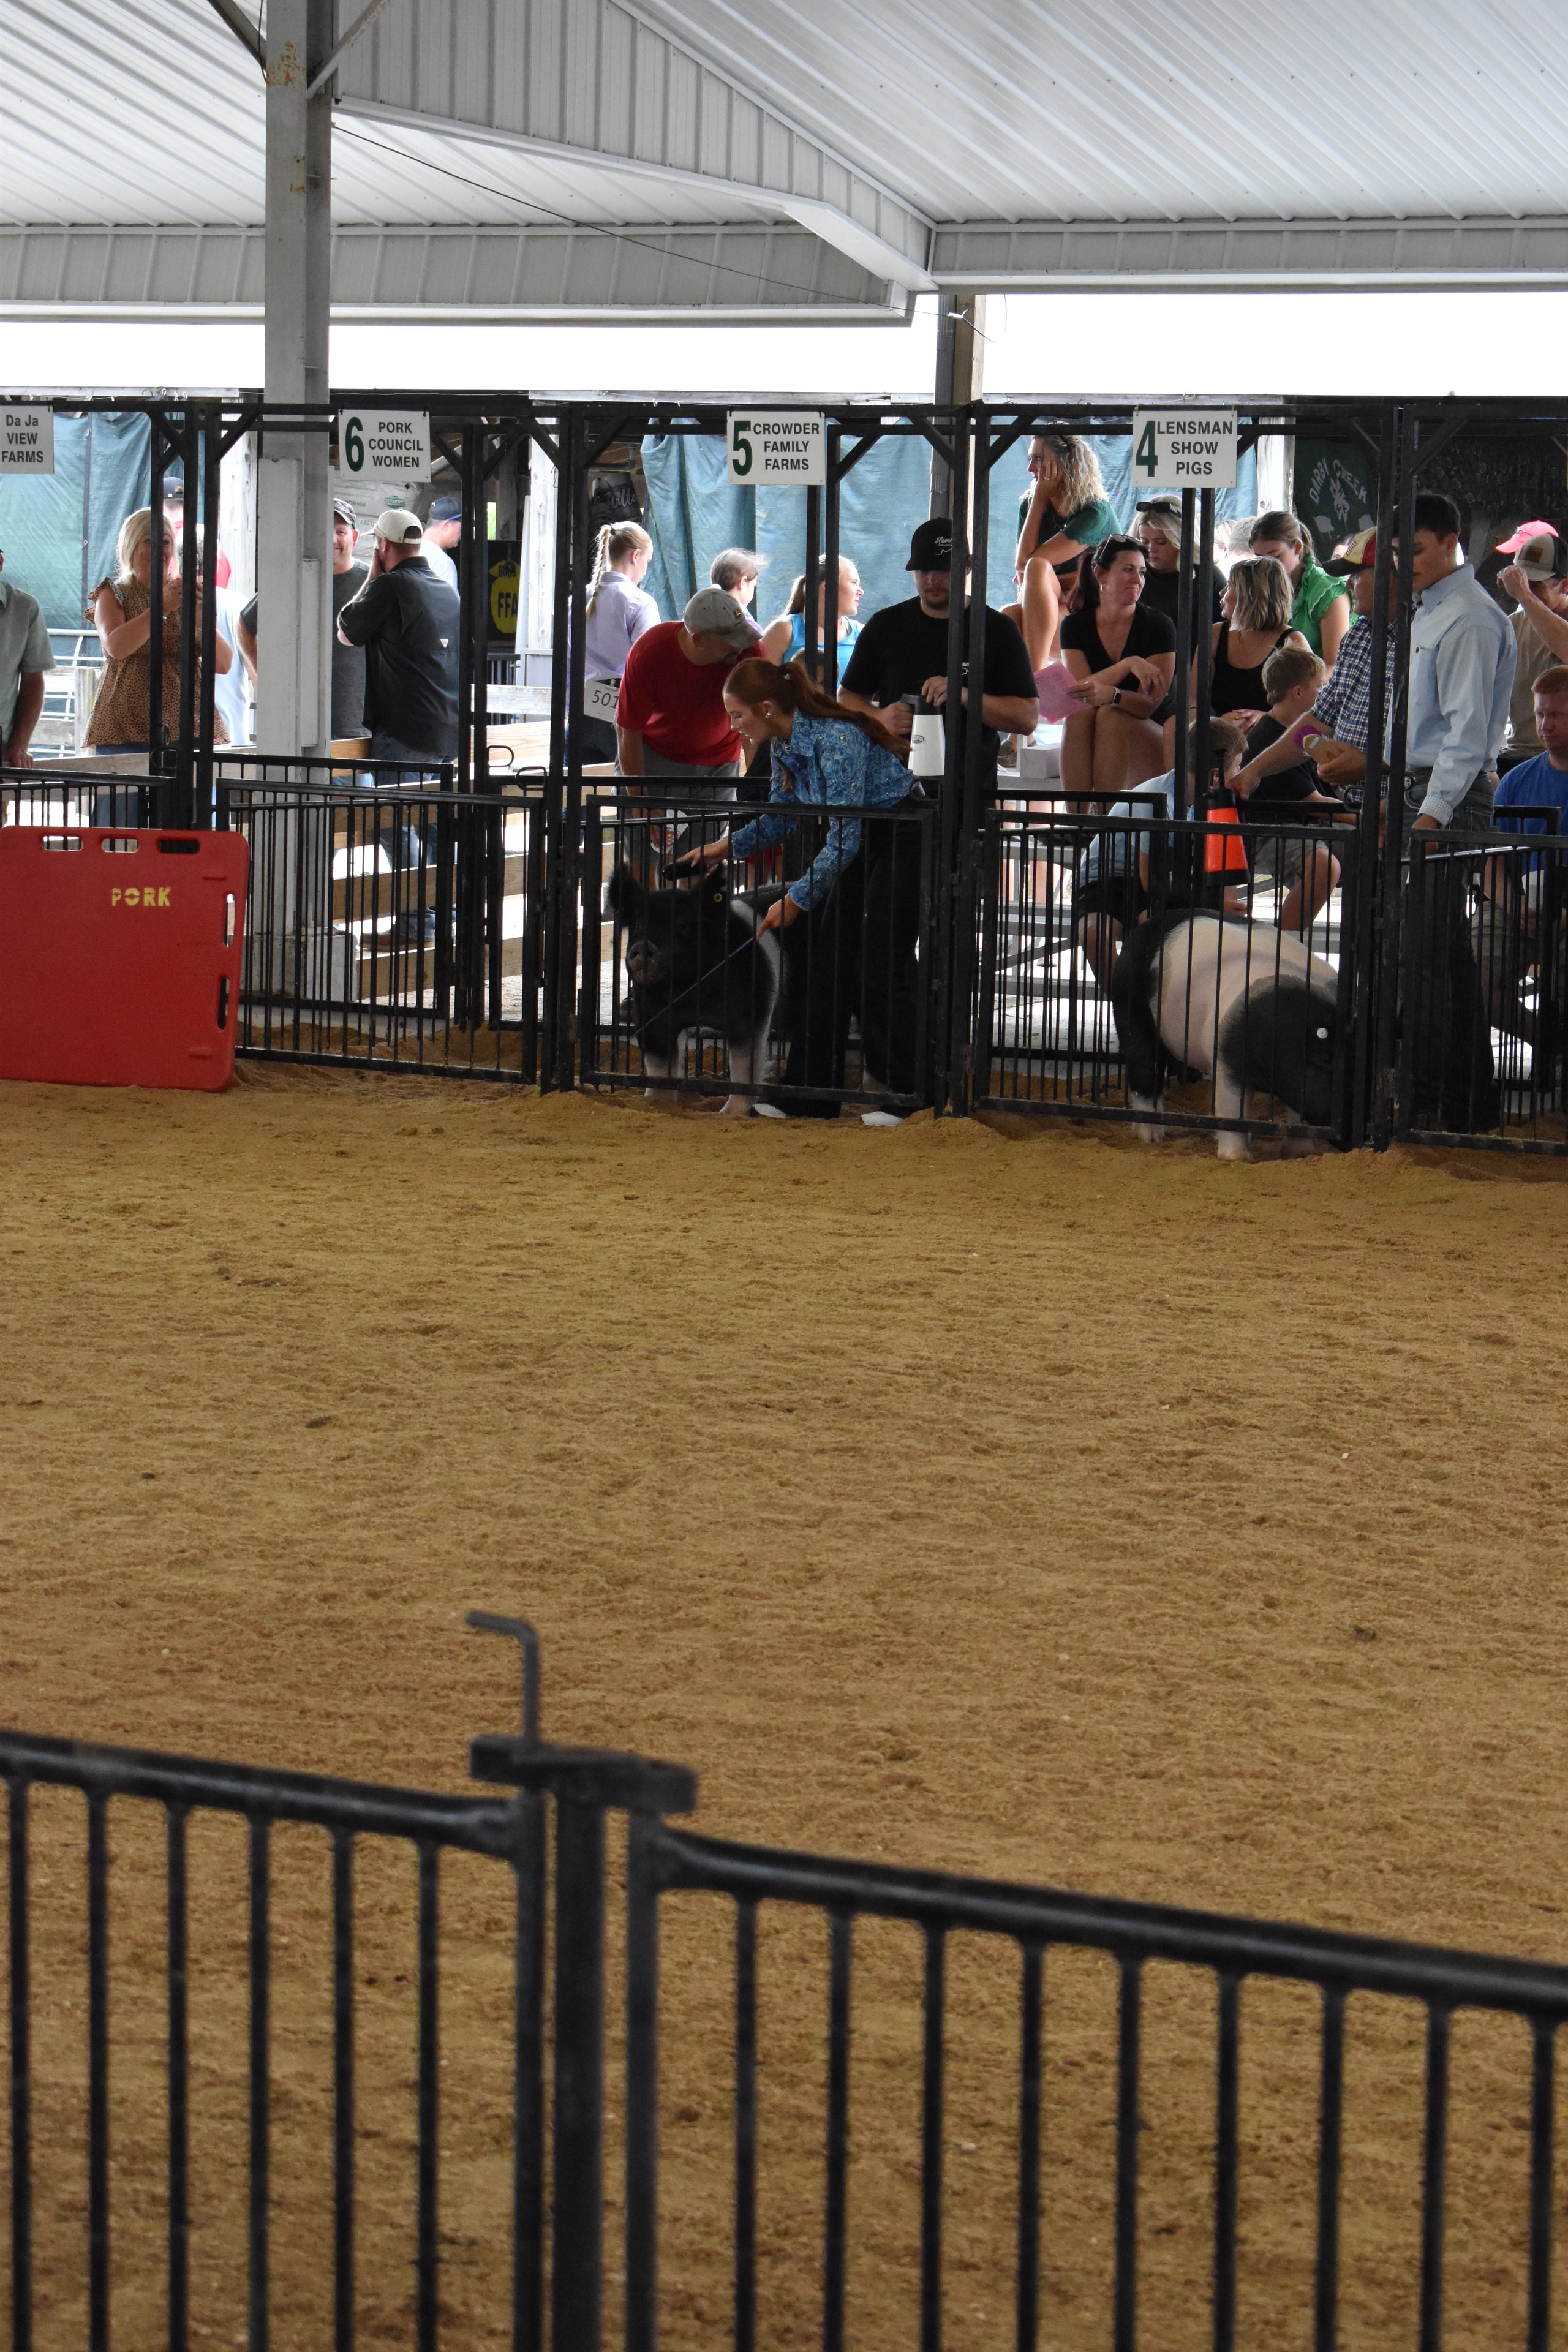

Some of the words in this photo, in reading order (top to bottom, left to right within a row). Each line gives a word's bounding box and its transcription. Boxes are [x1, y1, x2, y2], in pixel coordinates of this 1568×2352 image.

[6, 415, 21, 426] Da
[25, 415, 39, 426] Ja
[379, 421, 412, 434] PORK
[753, 423, 820, 435] CROWDER
[1157, 421, 1233, 435] LENSMAN
[7, 432, 38, 445] VIEW
[345, 417, 364, 472] 6
[369, 439, 423, 451] COUNCIL
[733, 420, 753, 476] 5
[764, 441, 810, 452] FAMILY
[1136, 420, 1158, 477] 4
[1170, 441, 1218, 455] SHOW
[2, 451, 43, 463] FARMS
[372, 456, 420, 468] WOMEN
[765, 458, 809, 470] FARMS
[1175, 461, 1213, 475] PIGS
[1309, 458, 1329, 505] DARBY
[1333, 459, 1368, 504] CREEK
[497, 592, 518, 618] FFA
[591, 689, 619, 709] 501
[111, 886, 171, 907] PORK
